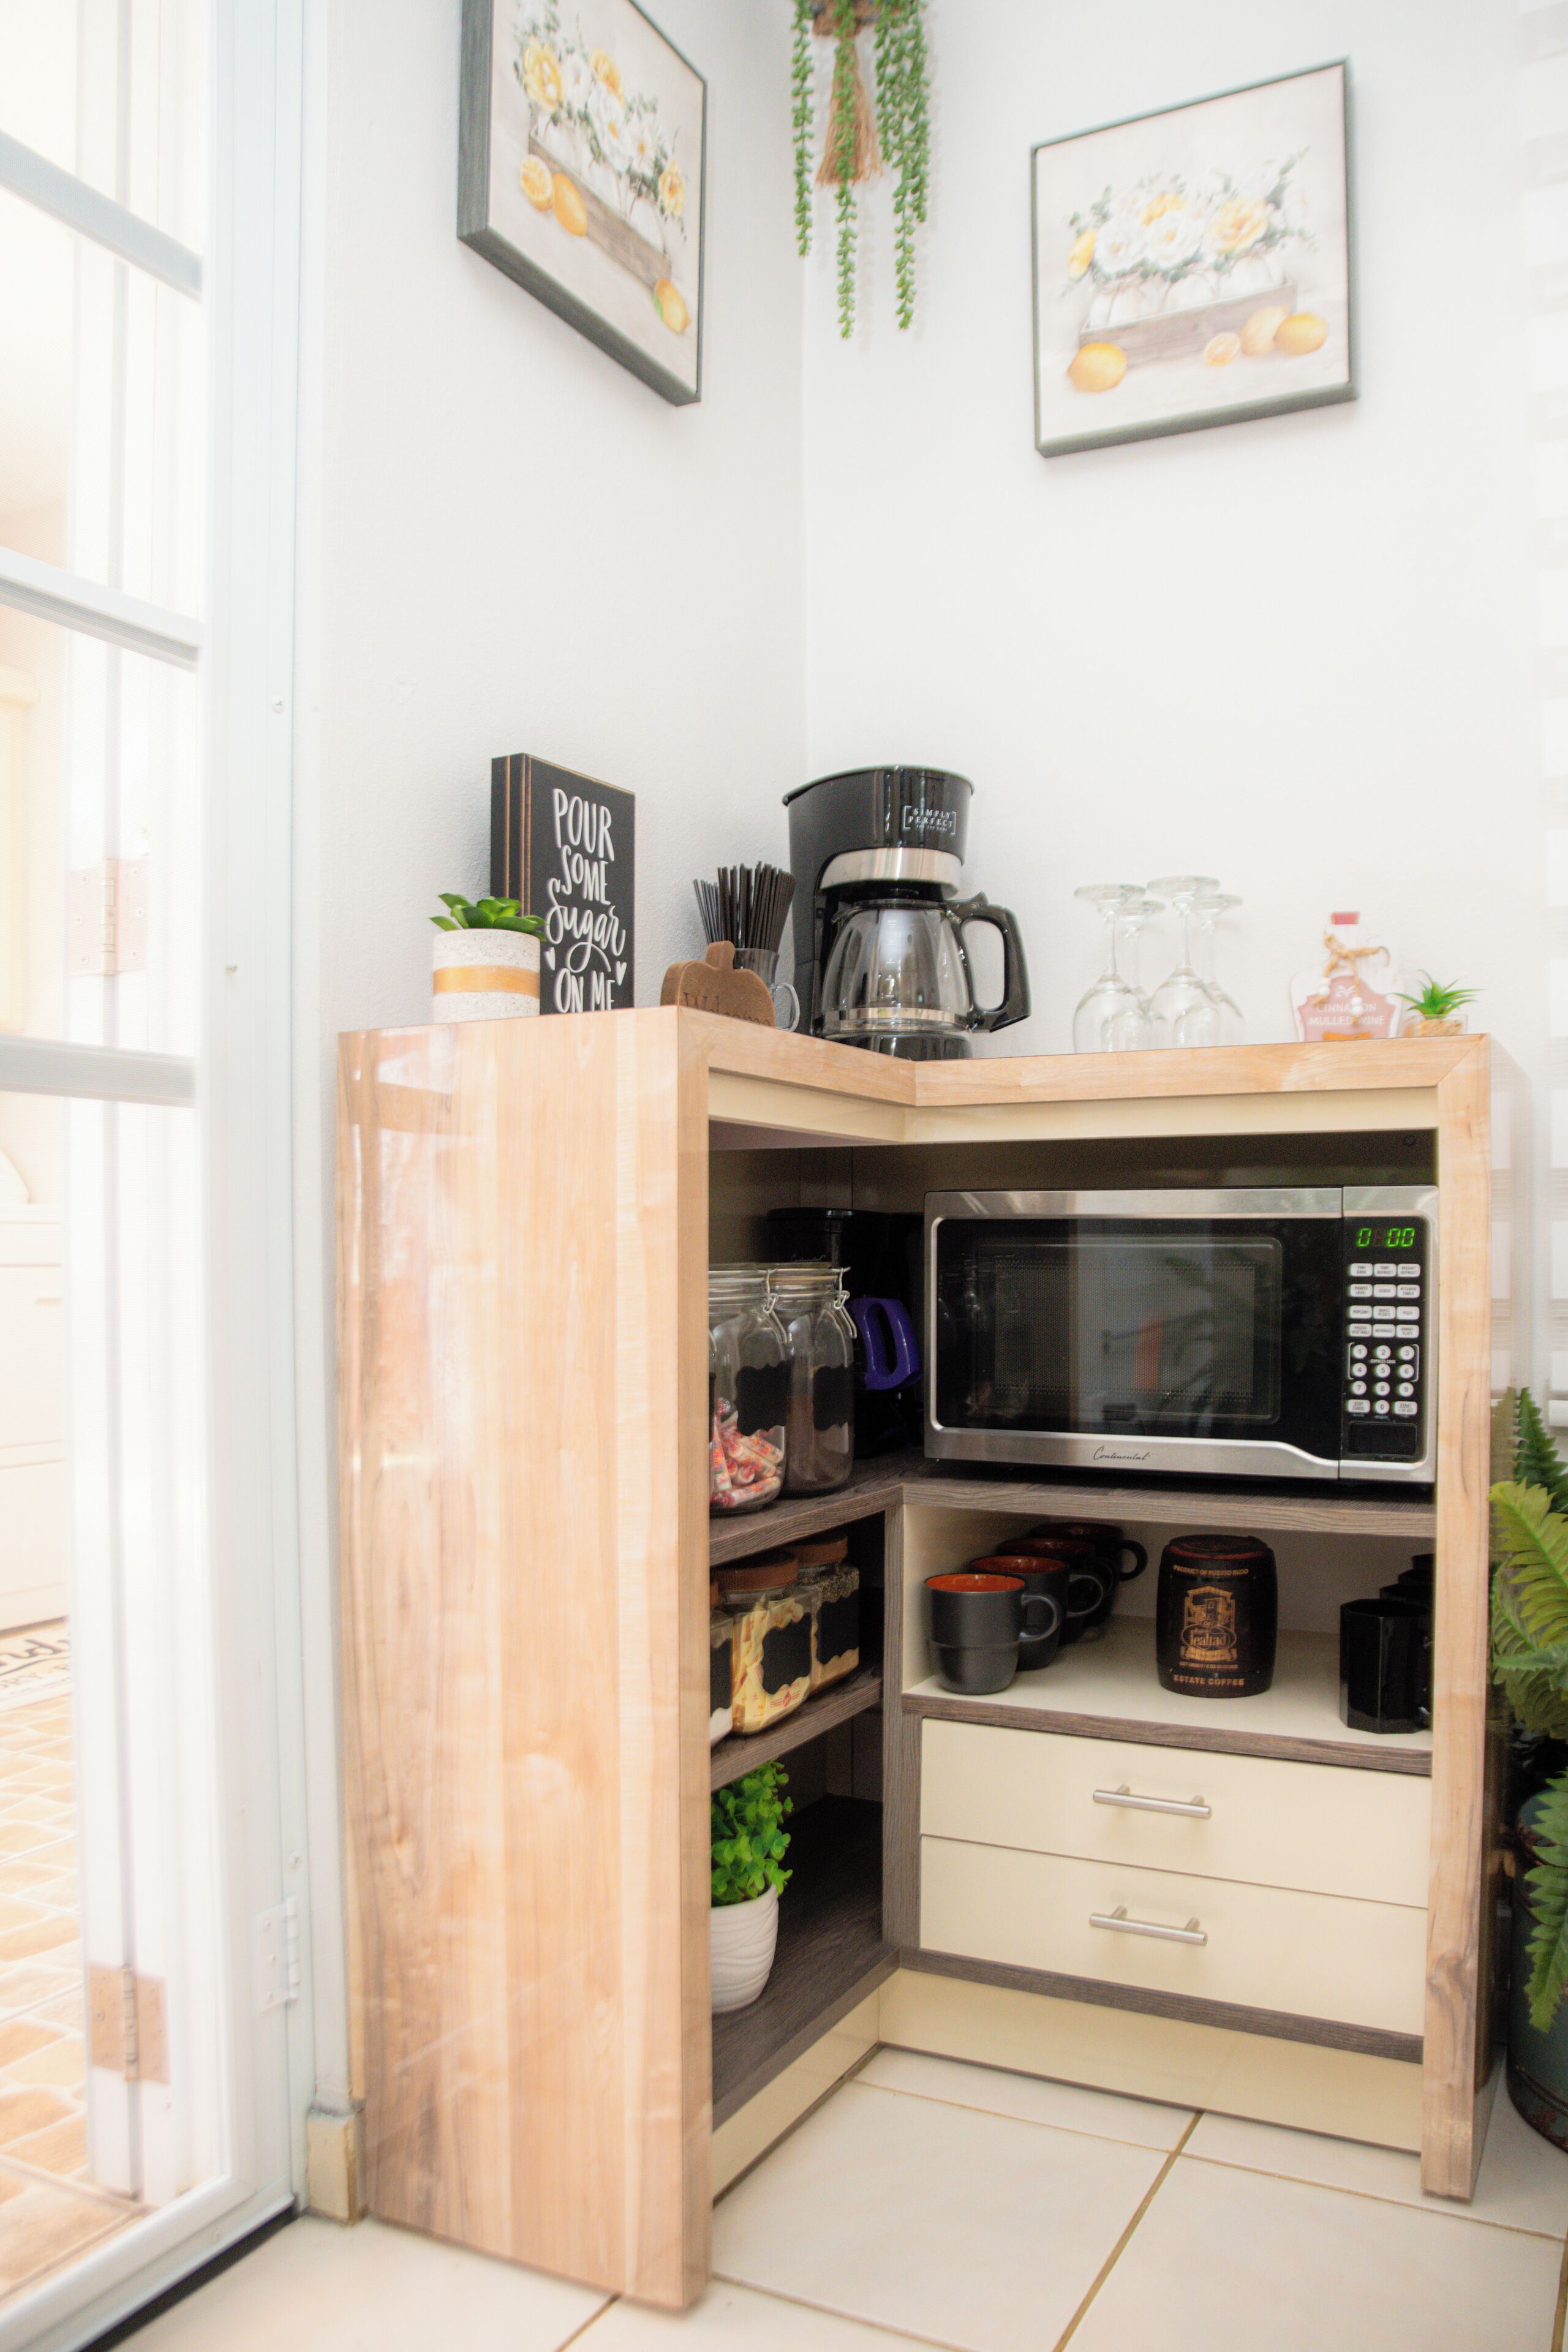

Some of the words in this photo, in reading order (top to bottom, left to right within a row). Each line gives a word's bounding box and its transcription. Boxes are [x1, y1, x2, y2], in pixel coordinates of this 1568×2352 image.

[914, 808, 951, 818] SIMPLY
[552, 788, 615, 861] POUR
[908, 816, 953, 827] PERFECT
[560, 844, 612, 905] SOME
[546, 878, 626, 973] Sugar
[556, 968, 584, 1014] ON
[1317, 1003, 1376, 1012] CINNAON
[1309, 1016, 1352, 1025] MULLED
[1093, 1446, 1150, 1461] Continental
[1173, 1564, 1199, 1575] PRODUCT
[1173, 1674, 1205, 1684] ESTATE
